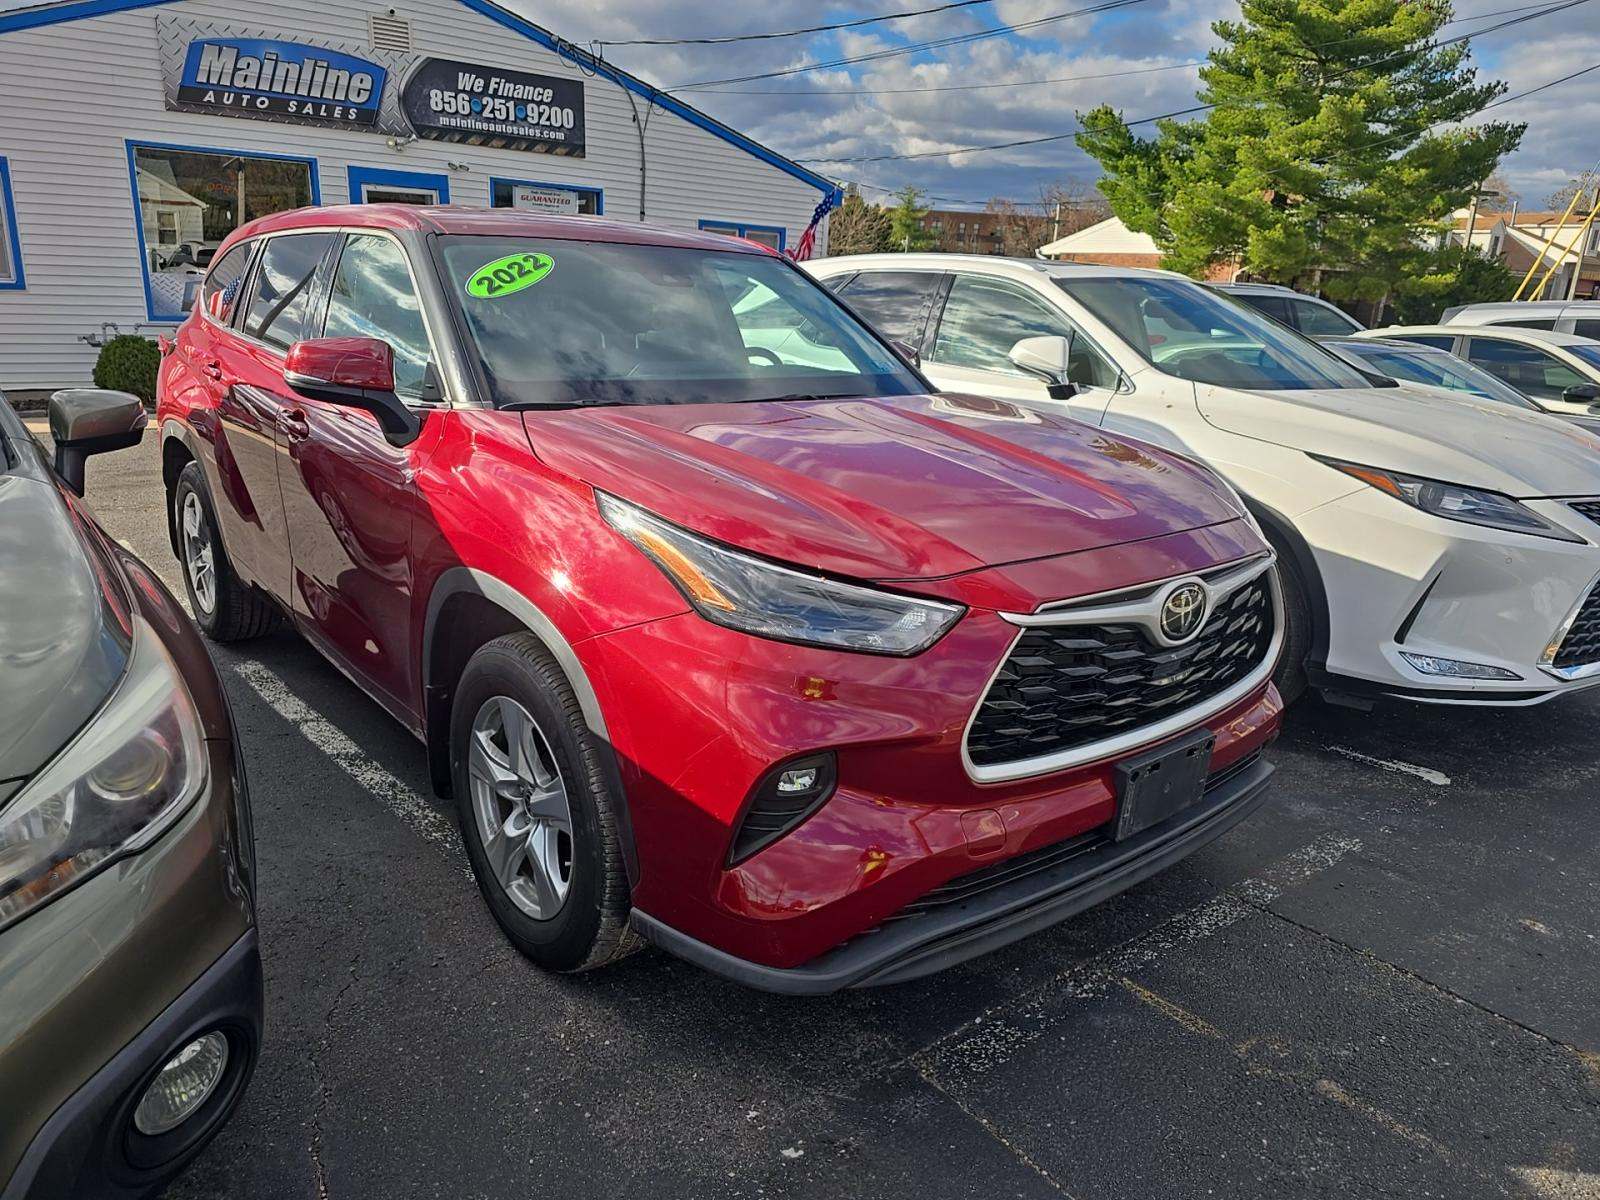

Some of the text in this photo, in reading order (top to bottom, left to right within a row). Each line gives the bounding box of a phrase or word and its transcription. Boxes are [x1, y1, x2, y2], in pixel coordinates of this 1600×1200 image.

[196, 43, 373, 104] Mainline
[457, 72, 553, 102] We Finance
[203, 90, 358, 120] AUTO SALES
[439, 115, 565, 140] mainlineautosales.com
[477, 255, 549, 295] 2022
